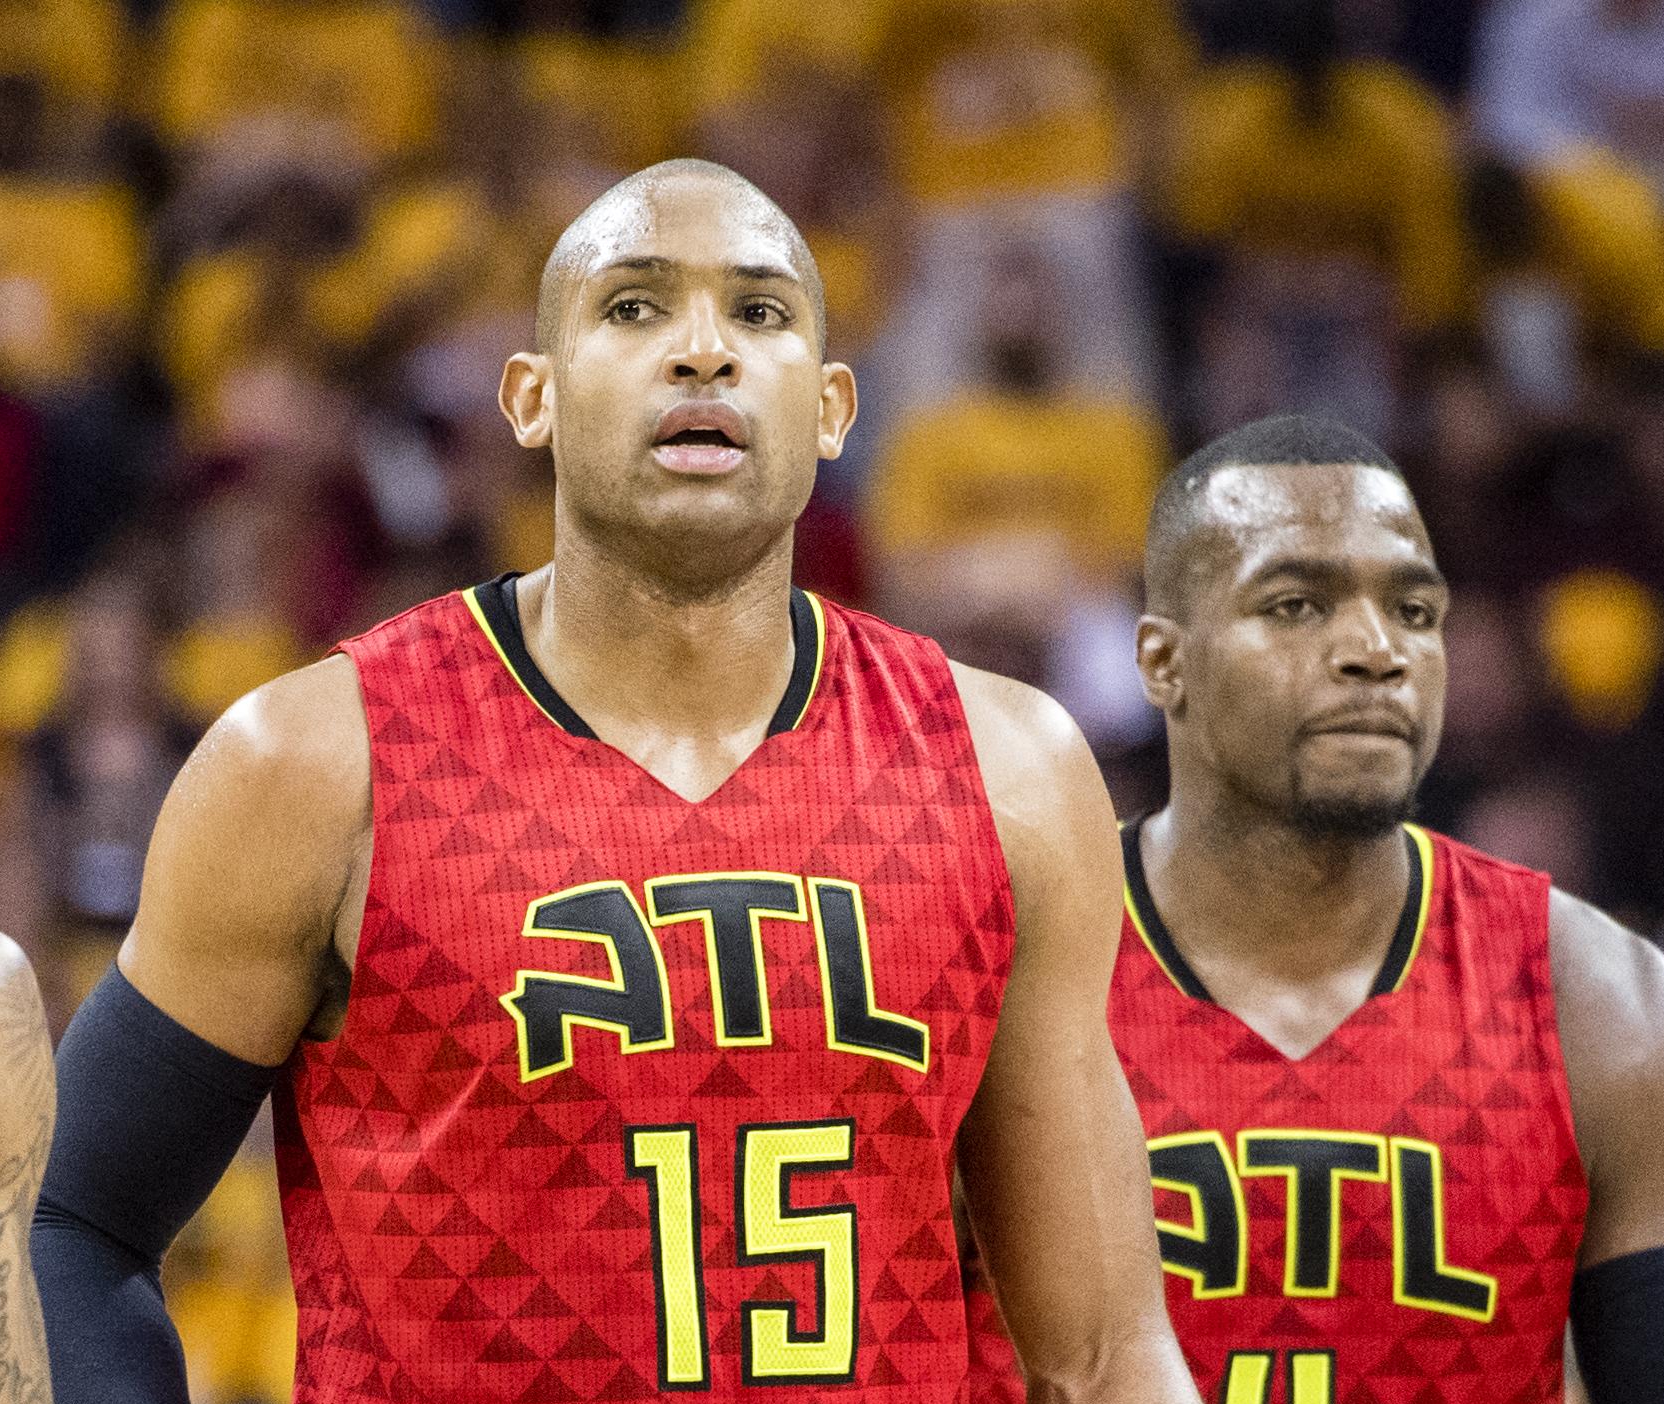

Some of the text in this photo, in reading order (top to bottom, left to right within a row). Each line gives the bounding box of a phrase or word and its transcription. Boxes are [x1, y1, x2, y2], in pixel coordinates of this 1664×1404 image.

[499, 871, 929, 1083] ATL
[624, 1117, 857, 1392] 15
[1147, 1129, 1498, 1323] ATL
